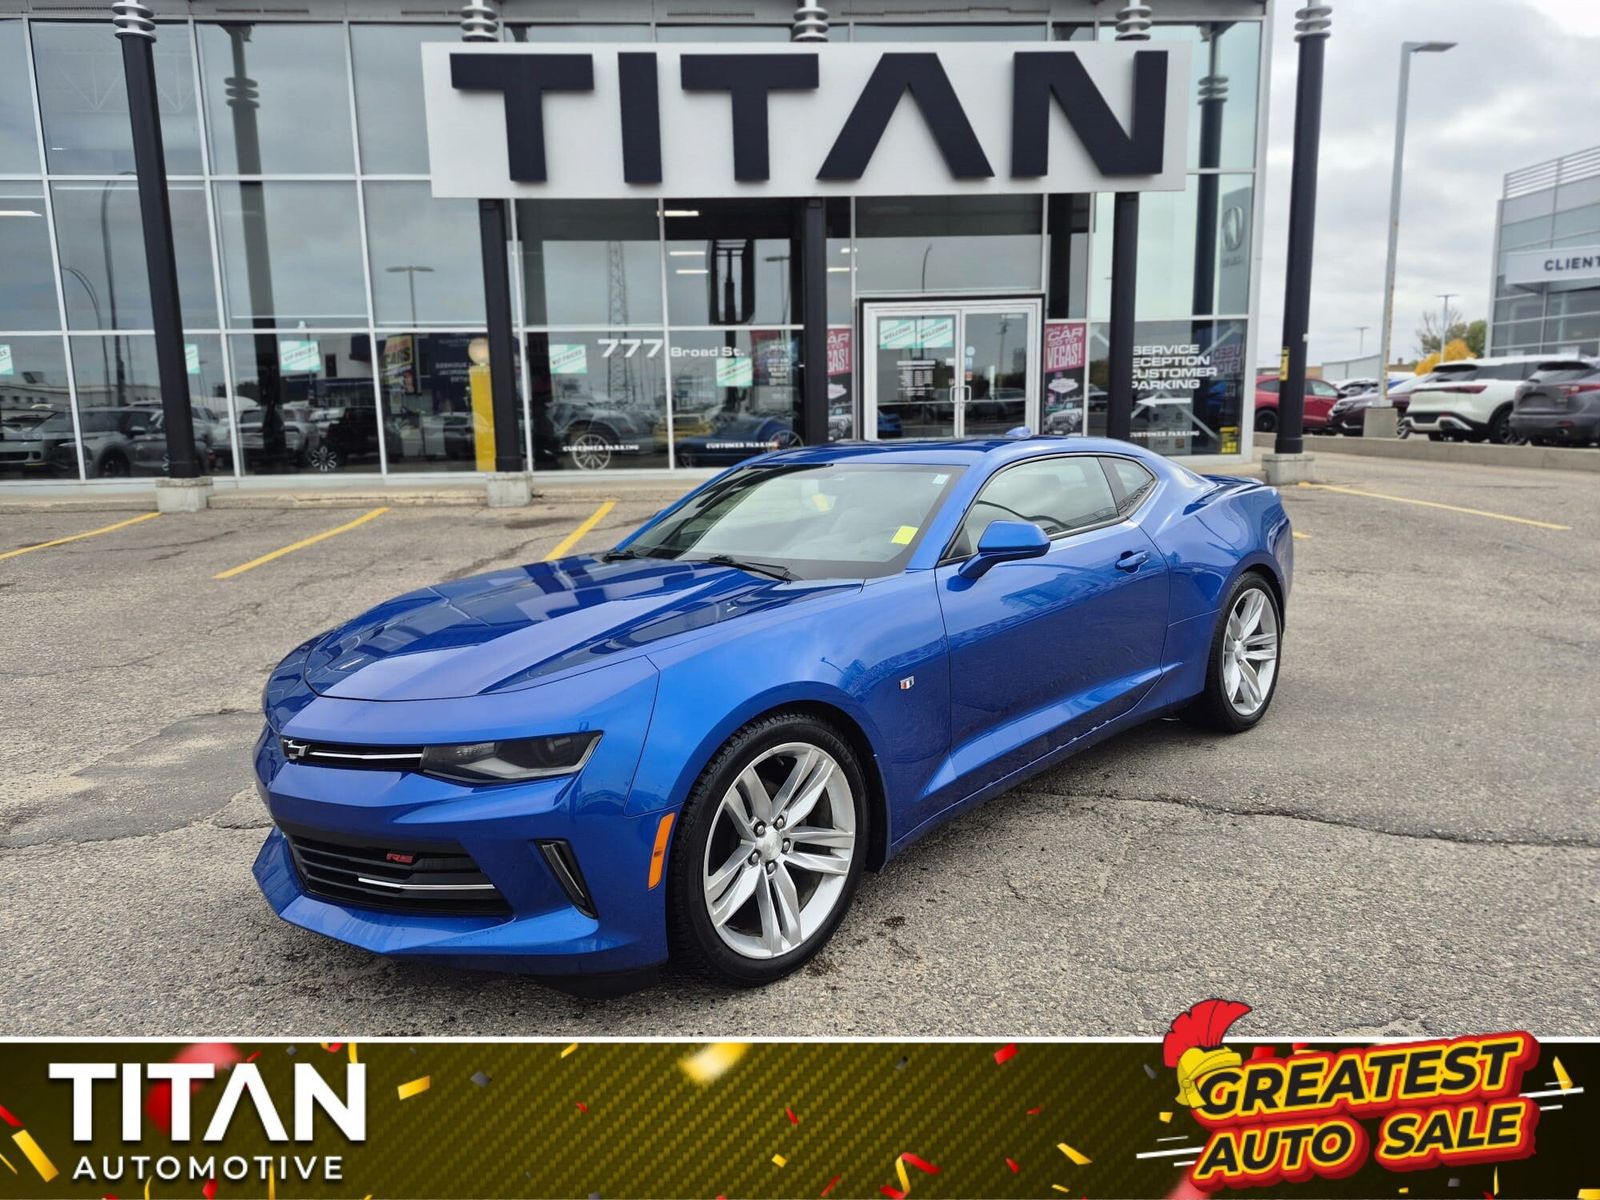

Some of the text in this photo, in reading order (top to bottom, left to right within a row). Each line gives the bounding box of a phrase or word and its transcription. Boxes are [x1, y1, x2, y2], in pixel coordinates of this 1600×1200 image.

[449, 50, 1167, 185] TITAN
[828, 333, 849, 344] AR
[1048, 327, 1083, 341] CAR
[597, 338, 745, 358] 777 Broad St.
[1133, 344, 1199, 355] SERVICE
[1048, 342, 1082, 369] VEGAS!
[1133, 355, 1211, 368] ECEPTION
[386, 853, 414, 864] RS
